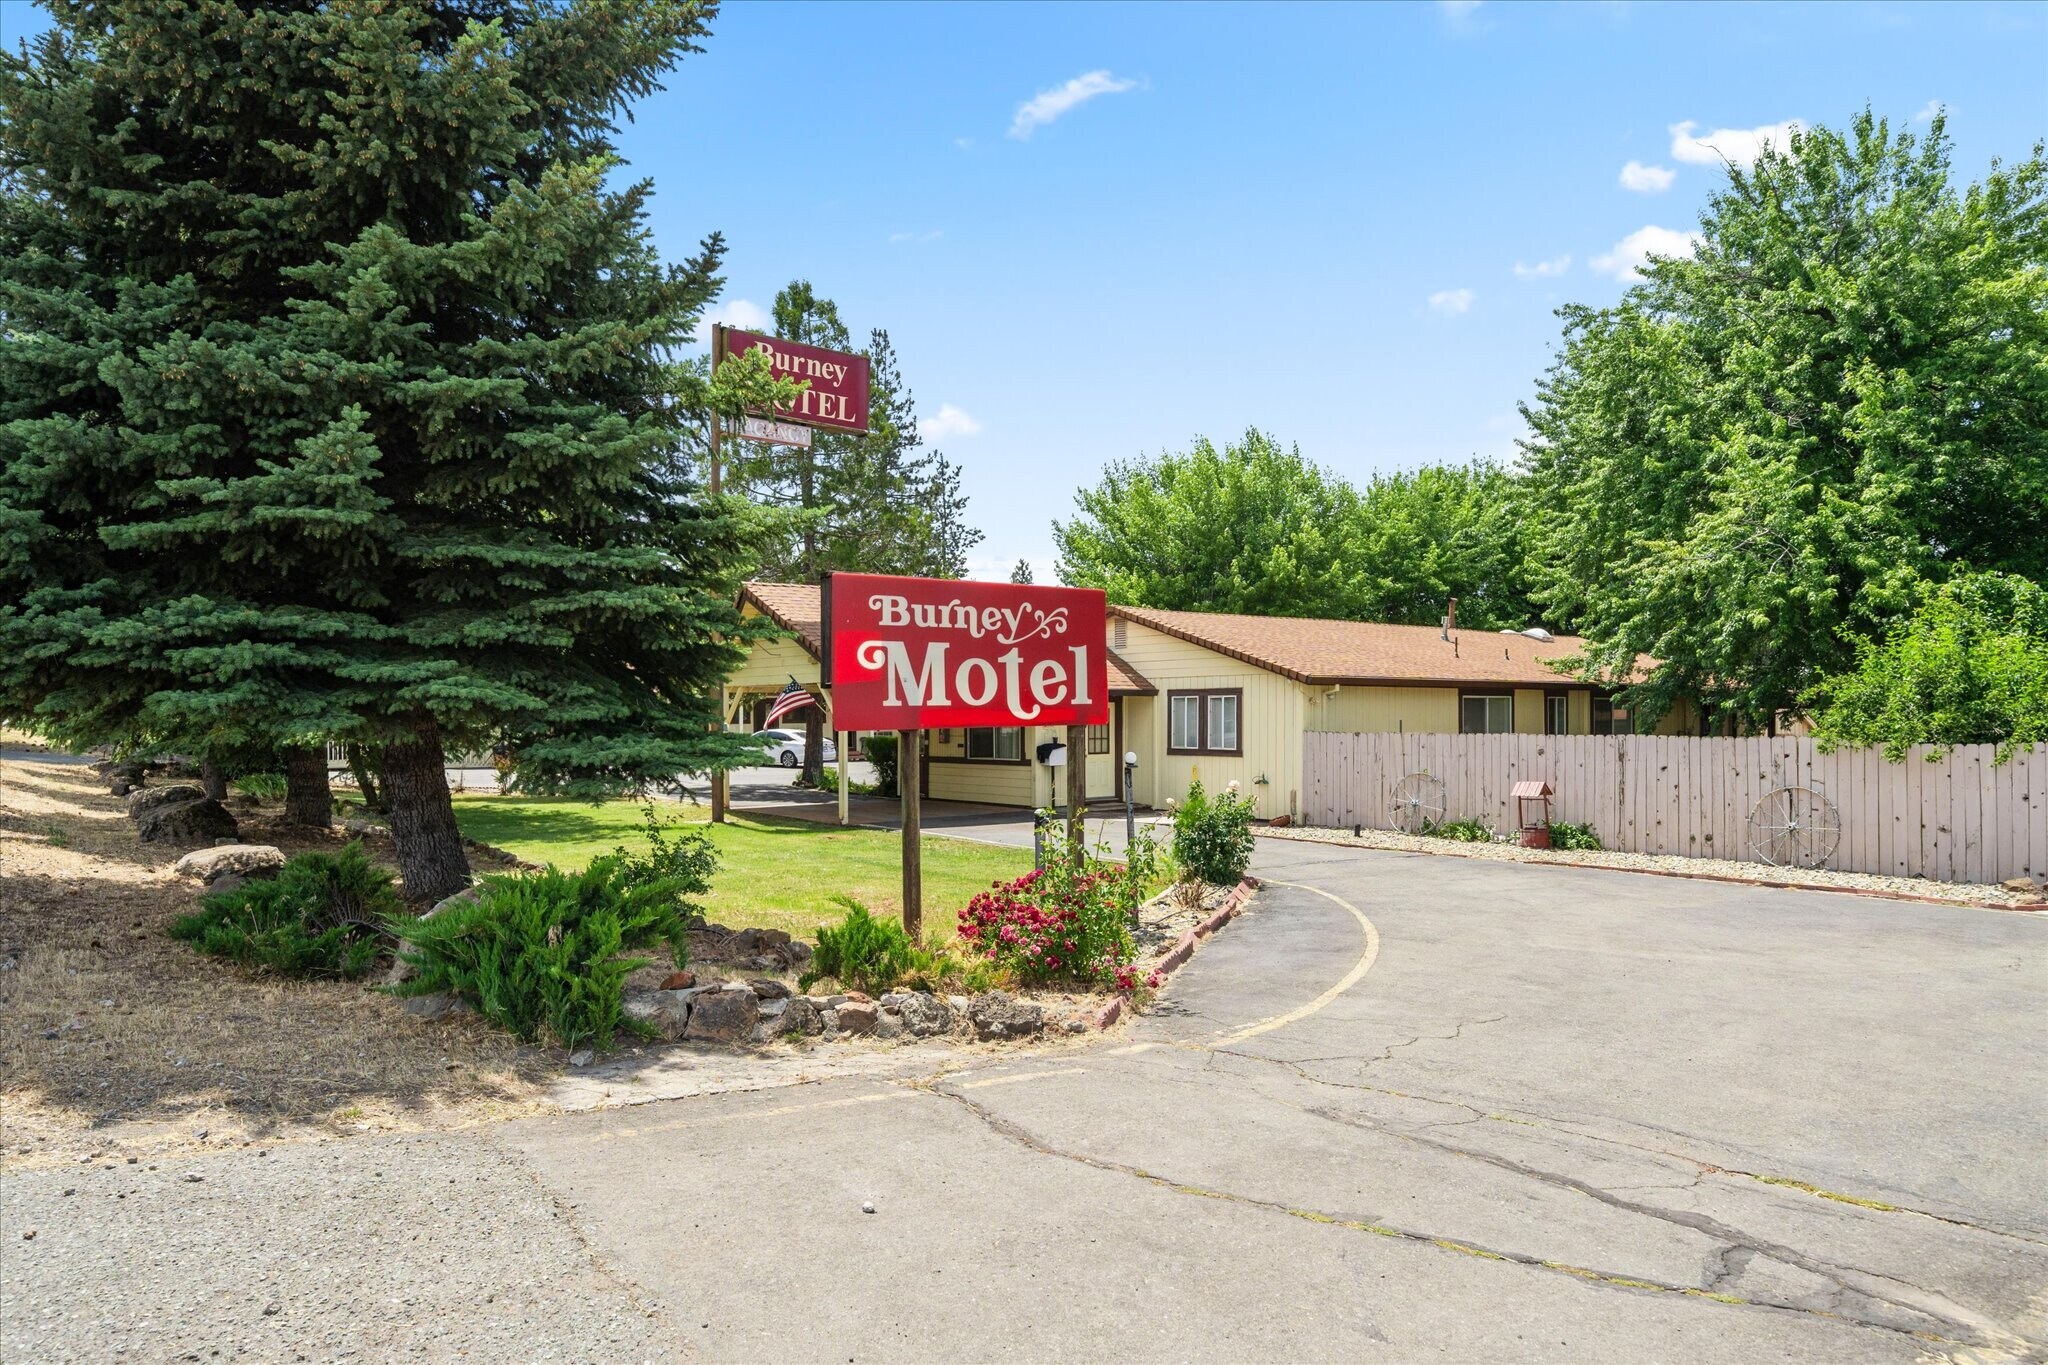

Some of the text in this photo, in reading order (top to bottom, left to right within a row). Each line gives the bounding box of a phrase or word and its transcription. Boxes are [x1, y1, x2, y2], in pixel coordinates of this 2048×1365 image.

[755, 341, 848, 388] Burney
[750, 388, 857, 423] TEL
[869, 594, 1068, 645] Burney
[857, 640, 1093, 720] Motel
